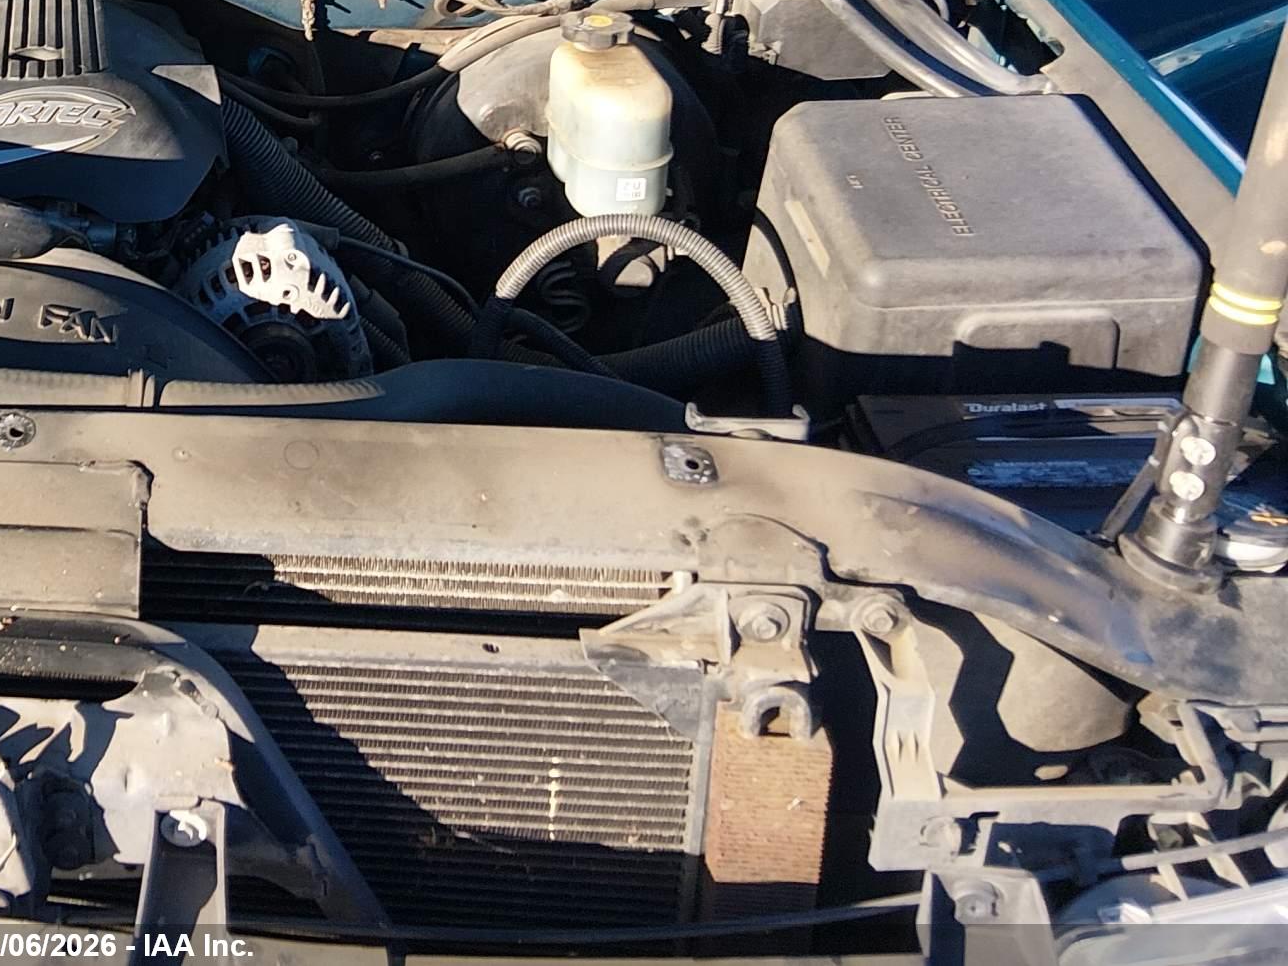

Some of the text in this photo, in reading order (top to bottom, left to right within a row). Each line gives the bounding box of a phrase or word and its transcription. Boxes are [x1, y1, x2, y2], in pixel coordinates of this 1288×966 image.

[883, 115, 975, 236] ELECTRICAL CENTER
[37, 303, 119, 346] FAN
[964, 401, 1048, 413] Duralast
